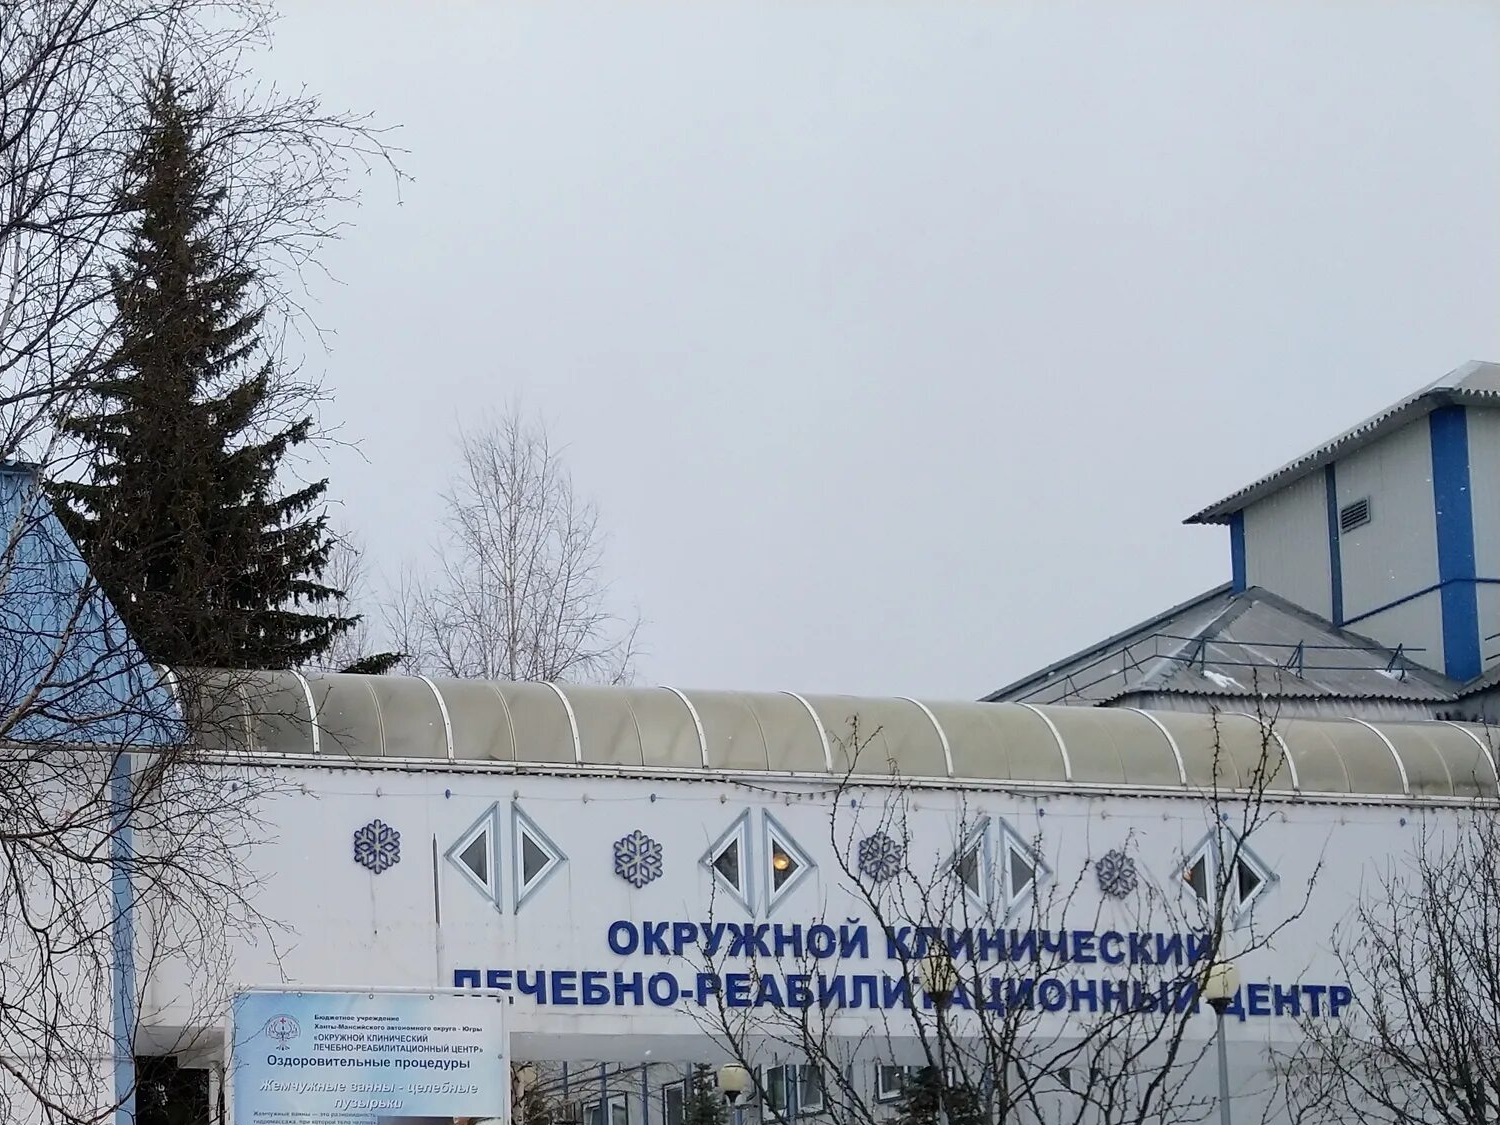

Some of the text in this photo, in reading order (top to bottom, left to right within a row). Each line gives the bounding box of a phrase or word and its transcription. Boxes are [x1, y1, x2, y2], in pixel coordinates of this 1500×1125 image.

[607, 917, 1214, 966] ОКРУЖНОЙ КЛИНИЧЕСКИЙ
[314, 1023, 385, 1031] Ханты-Мансийского
[387, 1024, 431, 1032] автономного
[313, 1034, 428, 1042] «ОКРУЖНОЙ КЛИНИЧЕСКИЙ
[313, 1043, 483, 1054] ЛЕЧЕБНО-РЕАБИЛИТАЦИОННЫЙ ЦЕНТР»
[267, 1054, 470, 1071] Оздоровительные процедуры
[259, 1080, 347, 1094] Жемчужные
[350, 1081, 396, 1093] ванны
[408, 1081, 479, 1095] целебные
[334, 1098, 403, 1111] пузырьки
